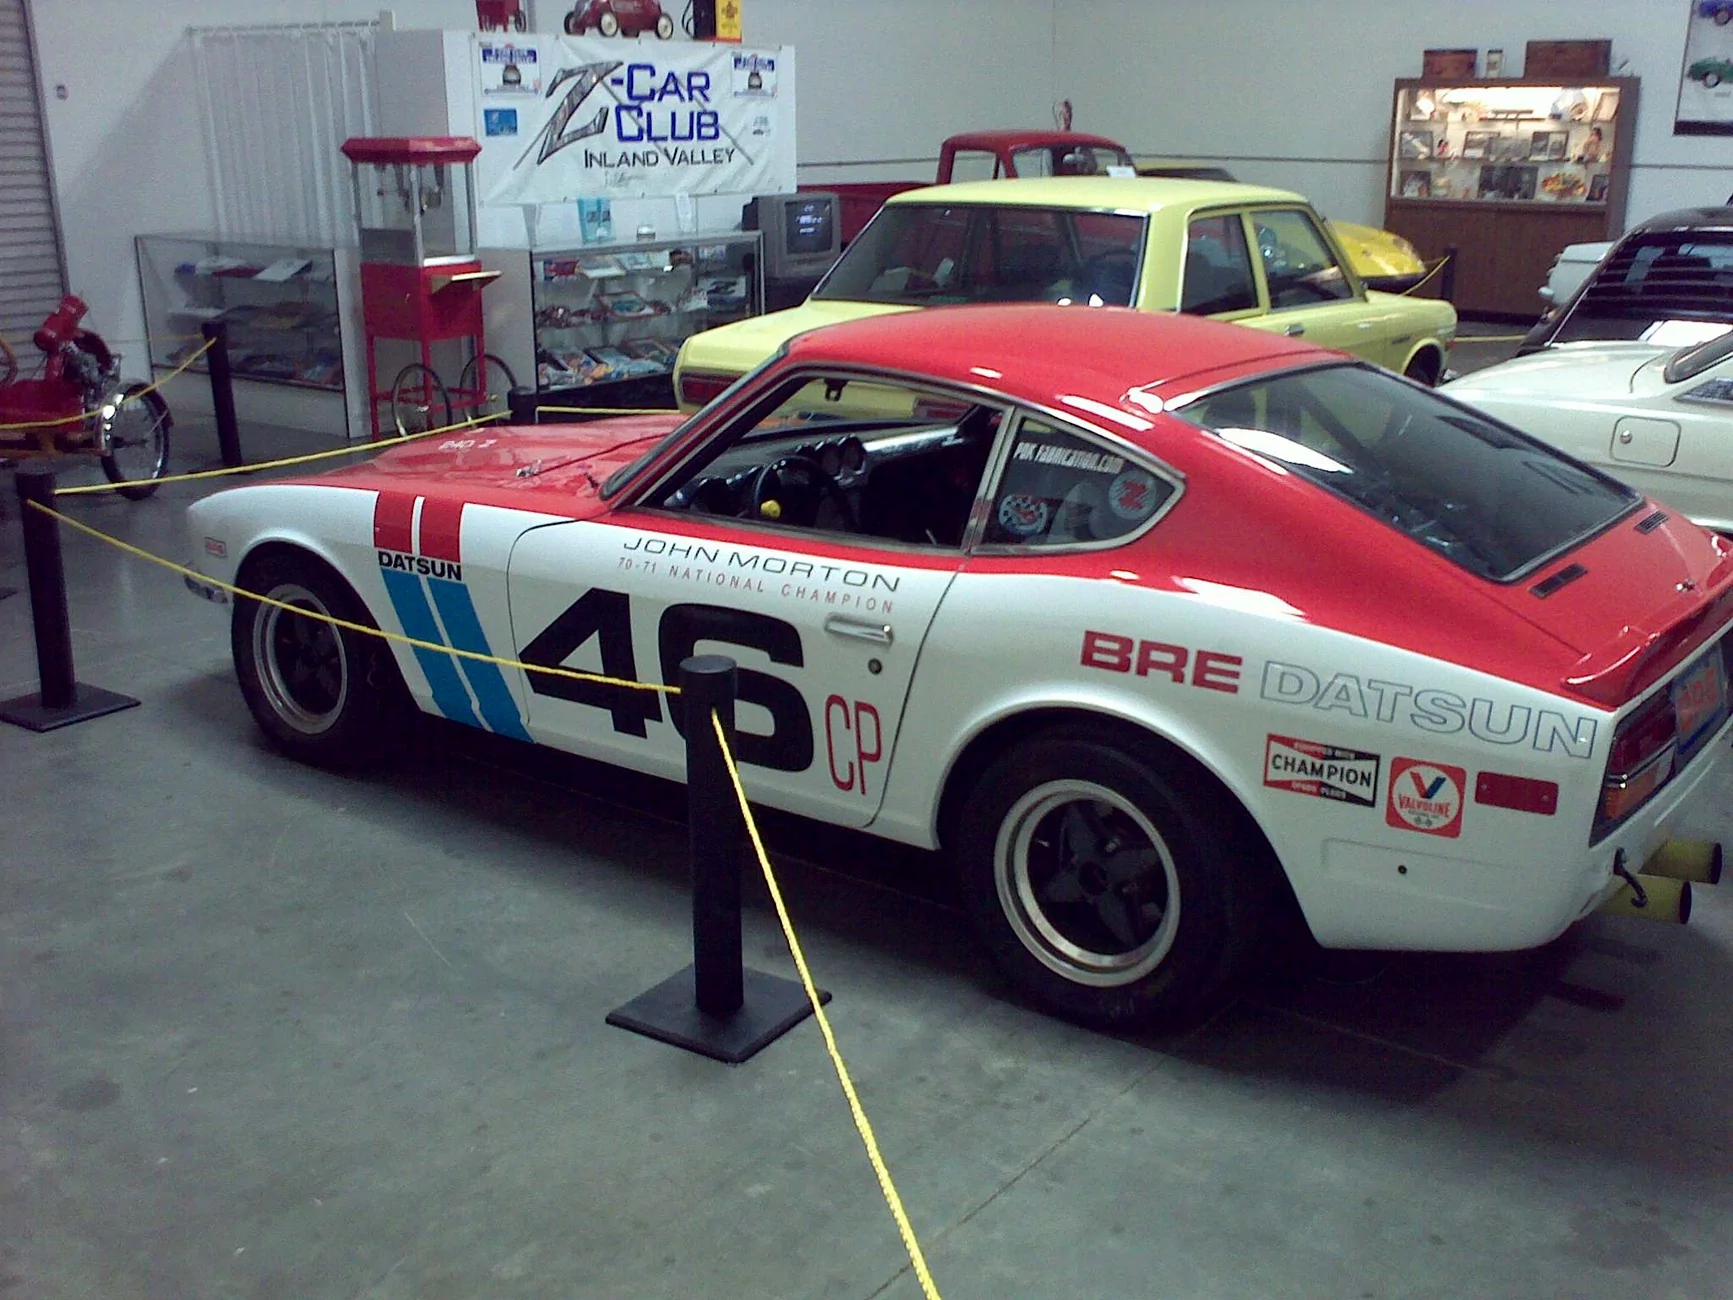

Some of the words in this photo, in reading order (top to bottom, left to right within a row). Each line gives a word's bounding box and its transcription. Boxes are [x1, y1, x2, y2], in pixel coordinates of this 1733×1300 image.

[614, 104, 720, 142] CLUB
[584, 148, 659, 168] INLAND
[663, 146, 735, 166] VALLEY
[377, 549, 463, 582] DATSUN
[617, 557, 657, 575] 70-71
[668, 564, 765, 593] NATIONAL
[781, 582, 894, 614] CHAMPION
[623, 536, 720, 564] JOHN
[727, 551, 901, 593] MORTON
[518, 586, 815, 773] 46
[1081, 630, 1243, 694] BRE
[1259, 660, 1600, 760] DATSUN
[825, 693, 882, 796] CP
[1271, 753, 1373, 789] CHAMPION
[1398, 792, 1450, 819] VALVOLINE
